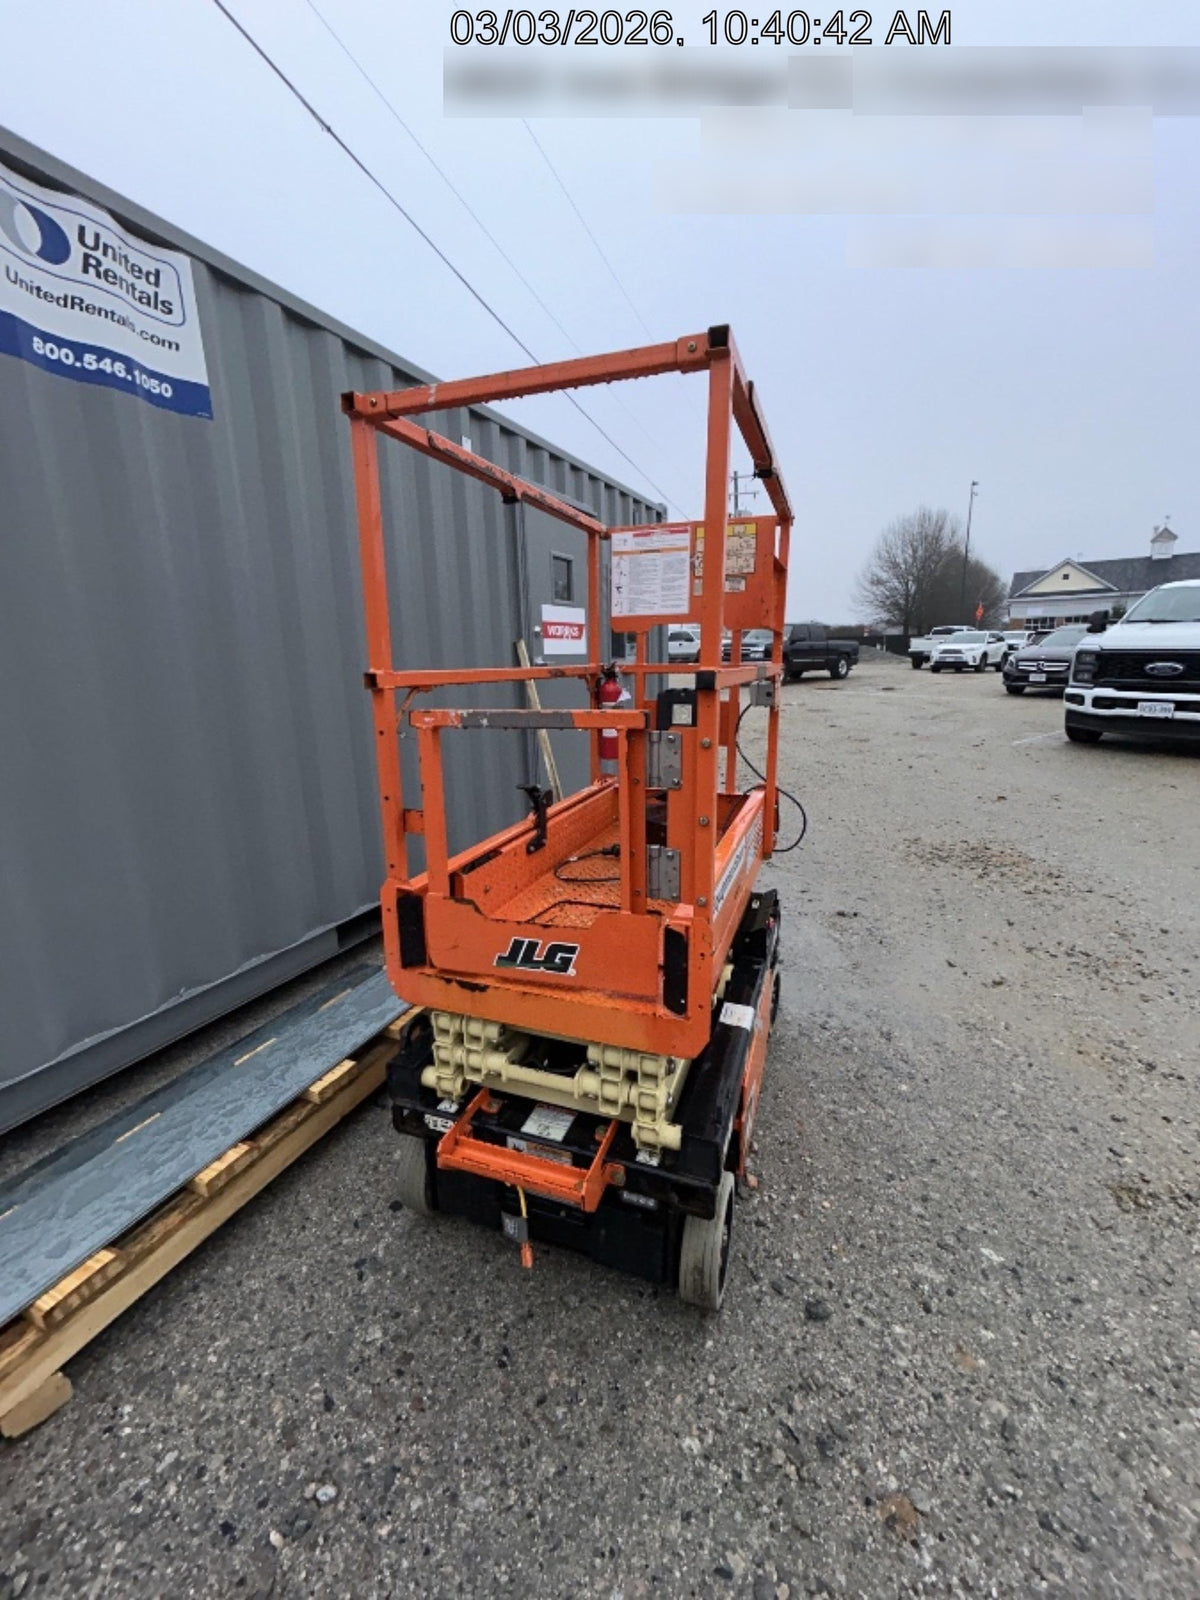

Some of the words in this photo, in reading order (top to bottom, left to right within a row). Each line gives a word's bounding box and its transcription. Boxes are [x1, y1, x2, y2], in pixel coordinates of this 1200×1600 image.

[77, 225, 161, 288] United
[81, 252, 174, 316] Rentals
[5, 264, 181, 352] UnitedRentals.com
[32, 336, 173, 398] 800.546.1050
[493, 937, 580, 976] JLG
